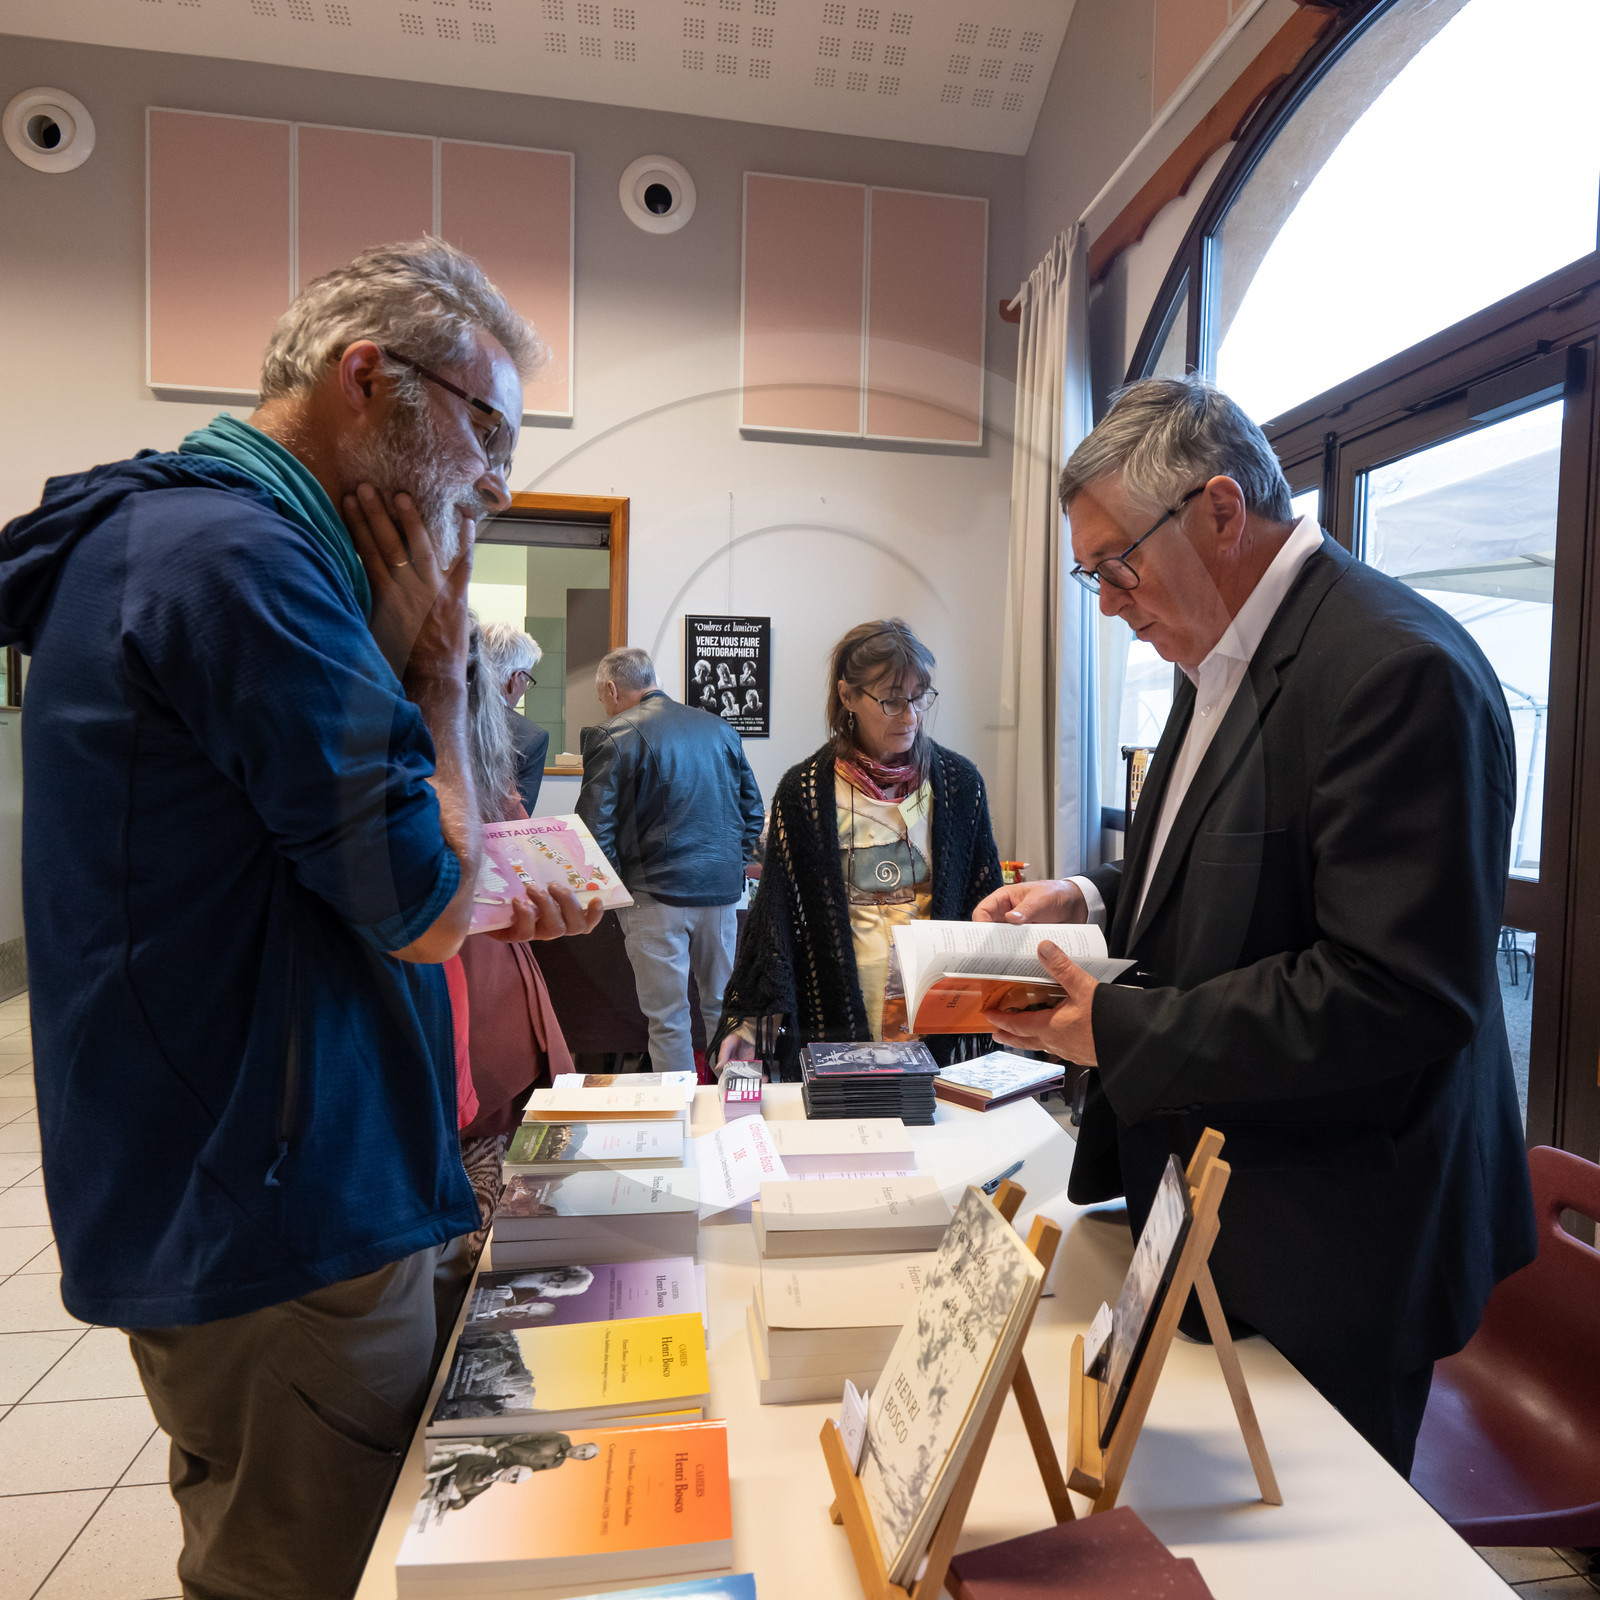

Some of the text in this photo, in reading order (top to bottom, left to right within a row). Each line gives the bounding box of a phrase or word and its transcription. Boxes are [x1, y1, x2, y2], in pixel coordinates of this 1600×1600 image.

[695, 636, 760, 647] VENEZ VOUS FAIRE
[723, 623, 731, 632] et
[696, 646, 759, 658] PHOTOGRAPHIER !
[760, 1155, 774, 1173] Bosco
[650, 1176, 664, 1203] Henri Bosco
[656, 1275, 667, 1309] Henri Bosco
[661, 1336, 674, 1378] Henri Bosco
[679, 1343, 688, 1368] CAHIERS
[894, 1372, 921, 1423] HENRI
[884, 1395, 909, 1444] BOSCO
[674, 1452, 689, 1513] Henri Bosco
[696, 1463, 705, 1498] CAHIERS
